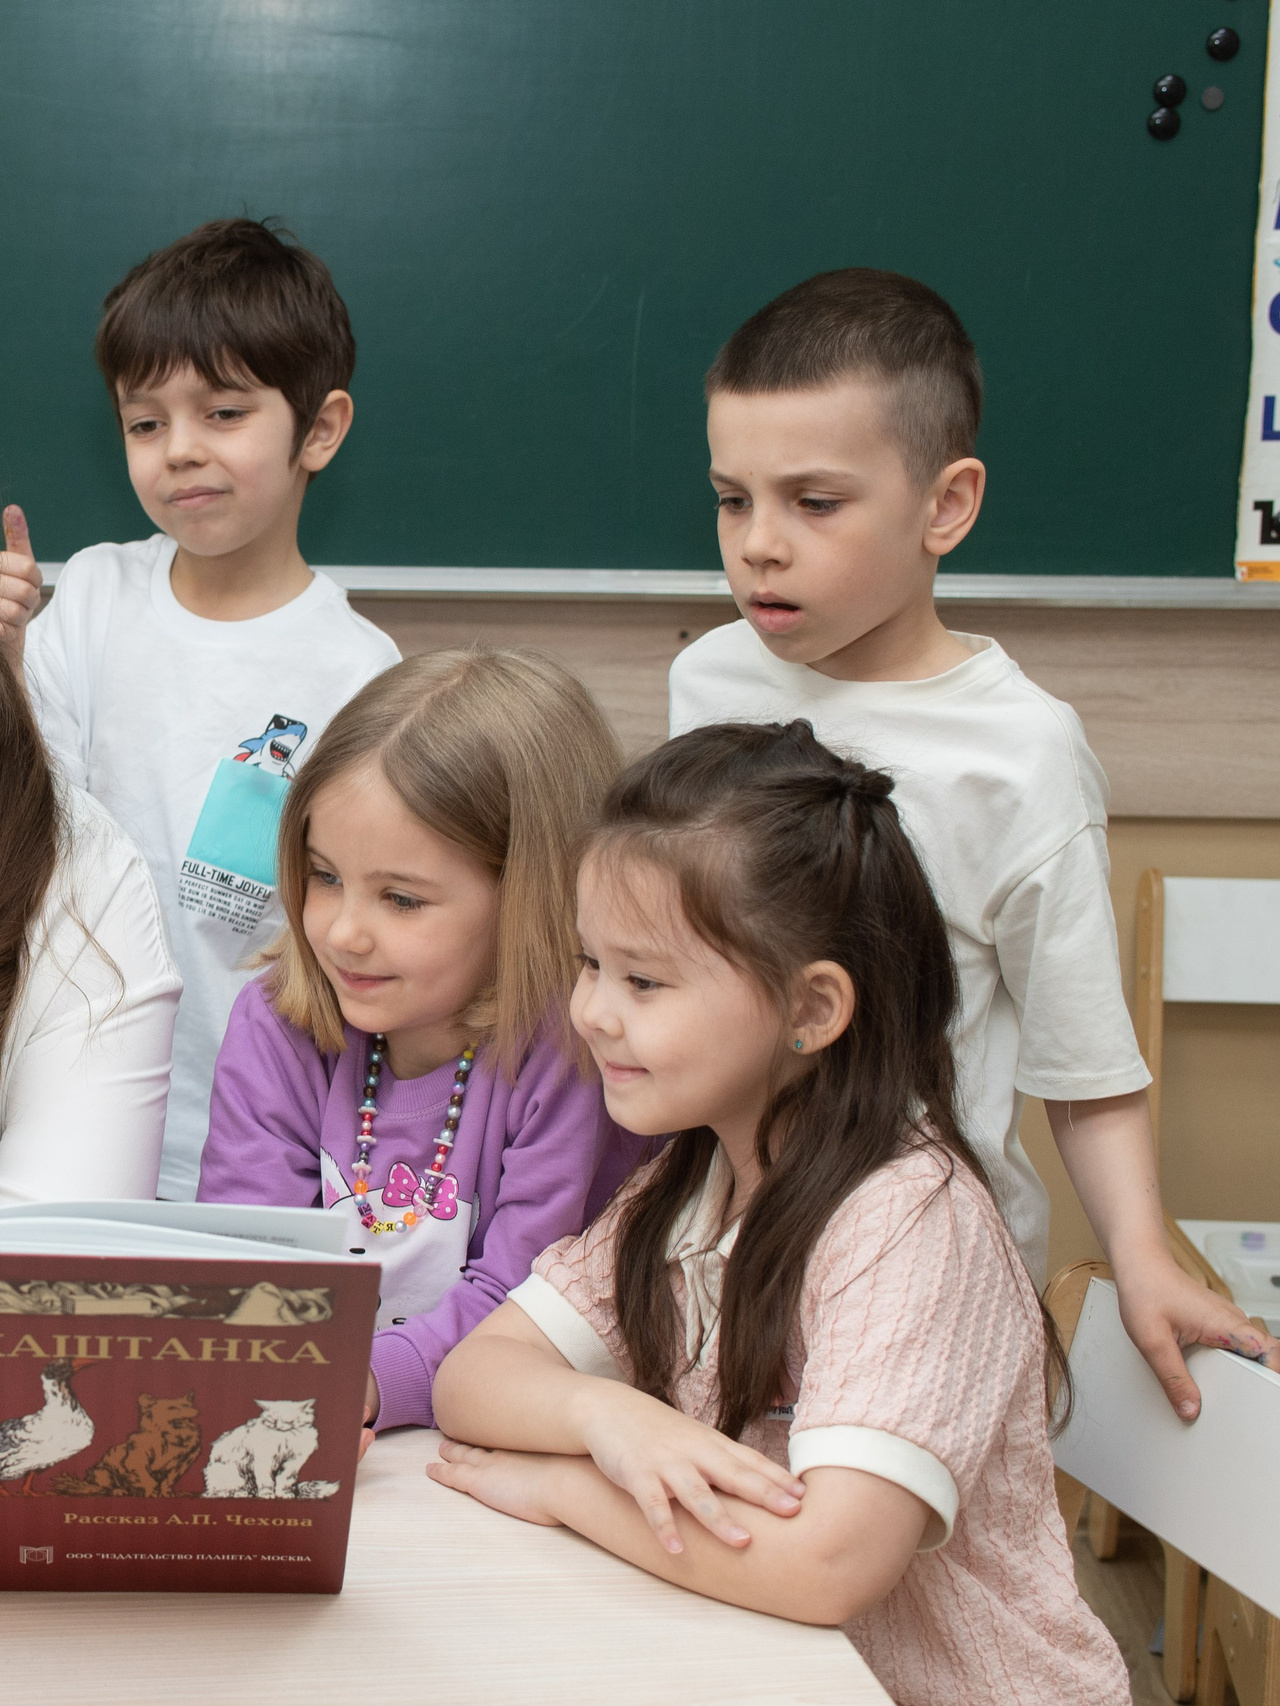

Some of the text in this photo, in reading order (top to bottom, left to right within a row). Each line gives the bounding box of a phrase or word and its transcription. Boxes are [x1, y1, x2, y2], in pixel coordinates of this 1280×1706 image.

[181, 860, 236, 887] FULL-TIME
[184, 879, 209, 891] PERFECT
[210, 888, 232, 899] SUMMER
[233, 895, 244, 904] DAY
[188, 887, 200, 896] SUN
[234, 904, 244, 912] THE
[185, 903, 197, 912] YOU
[197, 907, 207, 915] LIE
[217, 913, 227, 921] THE
[228, 917, 245, 928] BEACH
[205, 901, 215, 909] THE
[230, 911, 240, 919] ARE
[63, 1512, 313, 1527] Рассказ А.П. Чехова
[66, 1552, 312, 1562] ООО "ИЗДАТЕЛЬСТВО ПЛАНЕТА" МОСКВА
